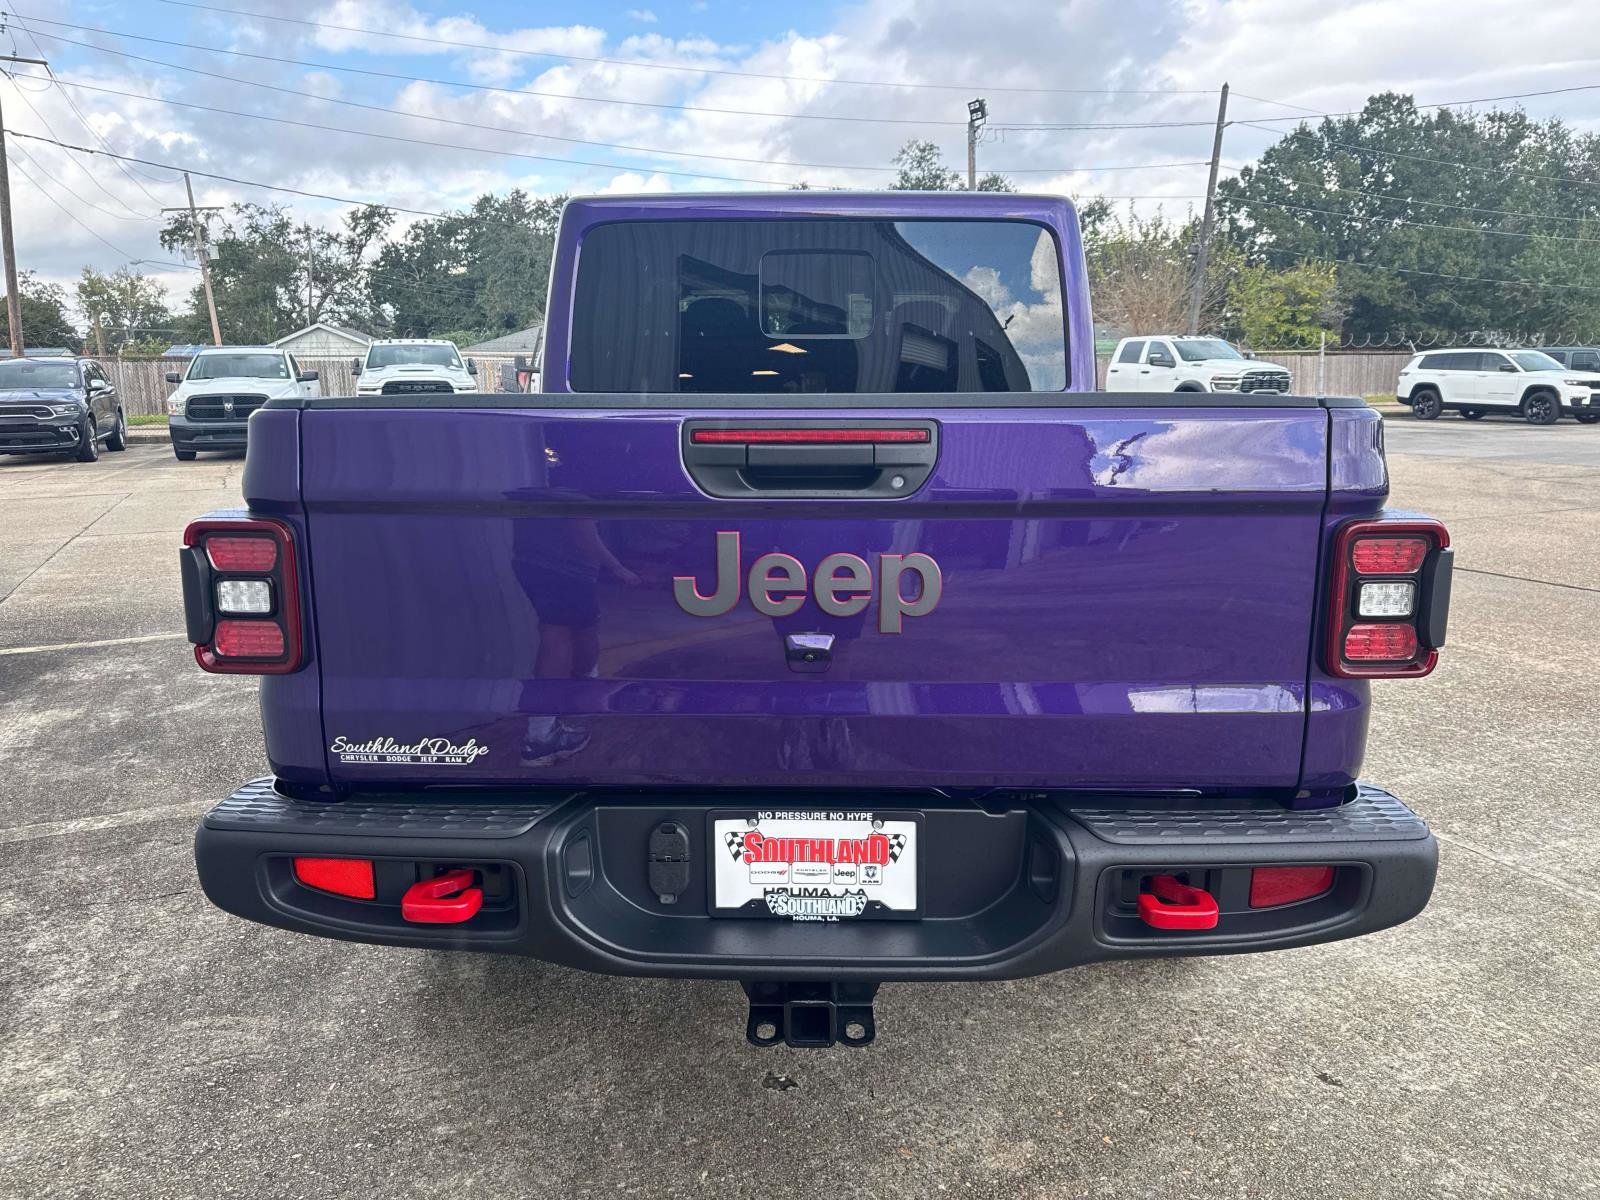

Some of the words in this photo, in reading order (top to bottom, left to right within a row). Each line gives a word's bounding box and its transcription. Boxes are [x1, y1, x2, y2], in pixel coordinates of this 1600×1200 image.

[672, 530, 943, 634] Jeep
[330, 736, 429, 755] Southland
[427, 738, 490, 763] Dodge
[340, 754, 379, 762] CHRYSLER
[758, 811, 772, 820] NO
[775, 811, 827, 821] PRESSURE
[829, 812, 844, 821] NO
[847, 812, 873, 821] HYPE
[834, 869, 855, 878] Jeep
